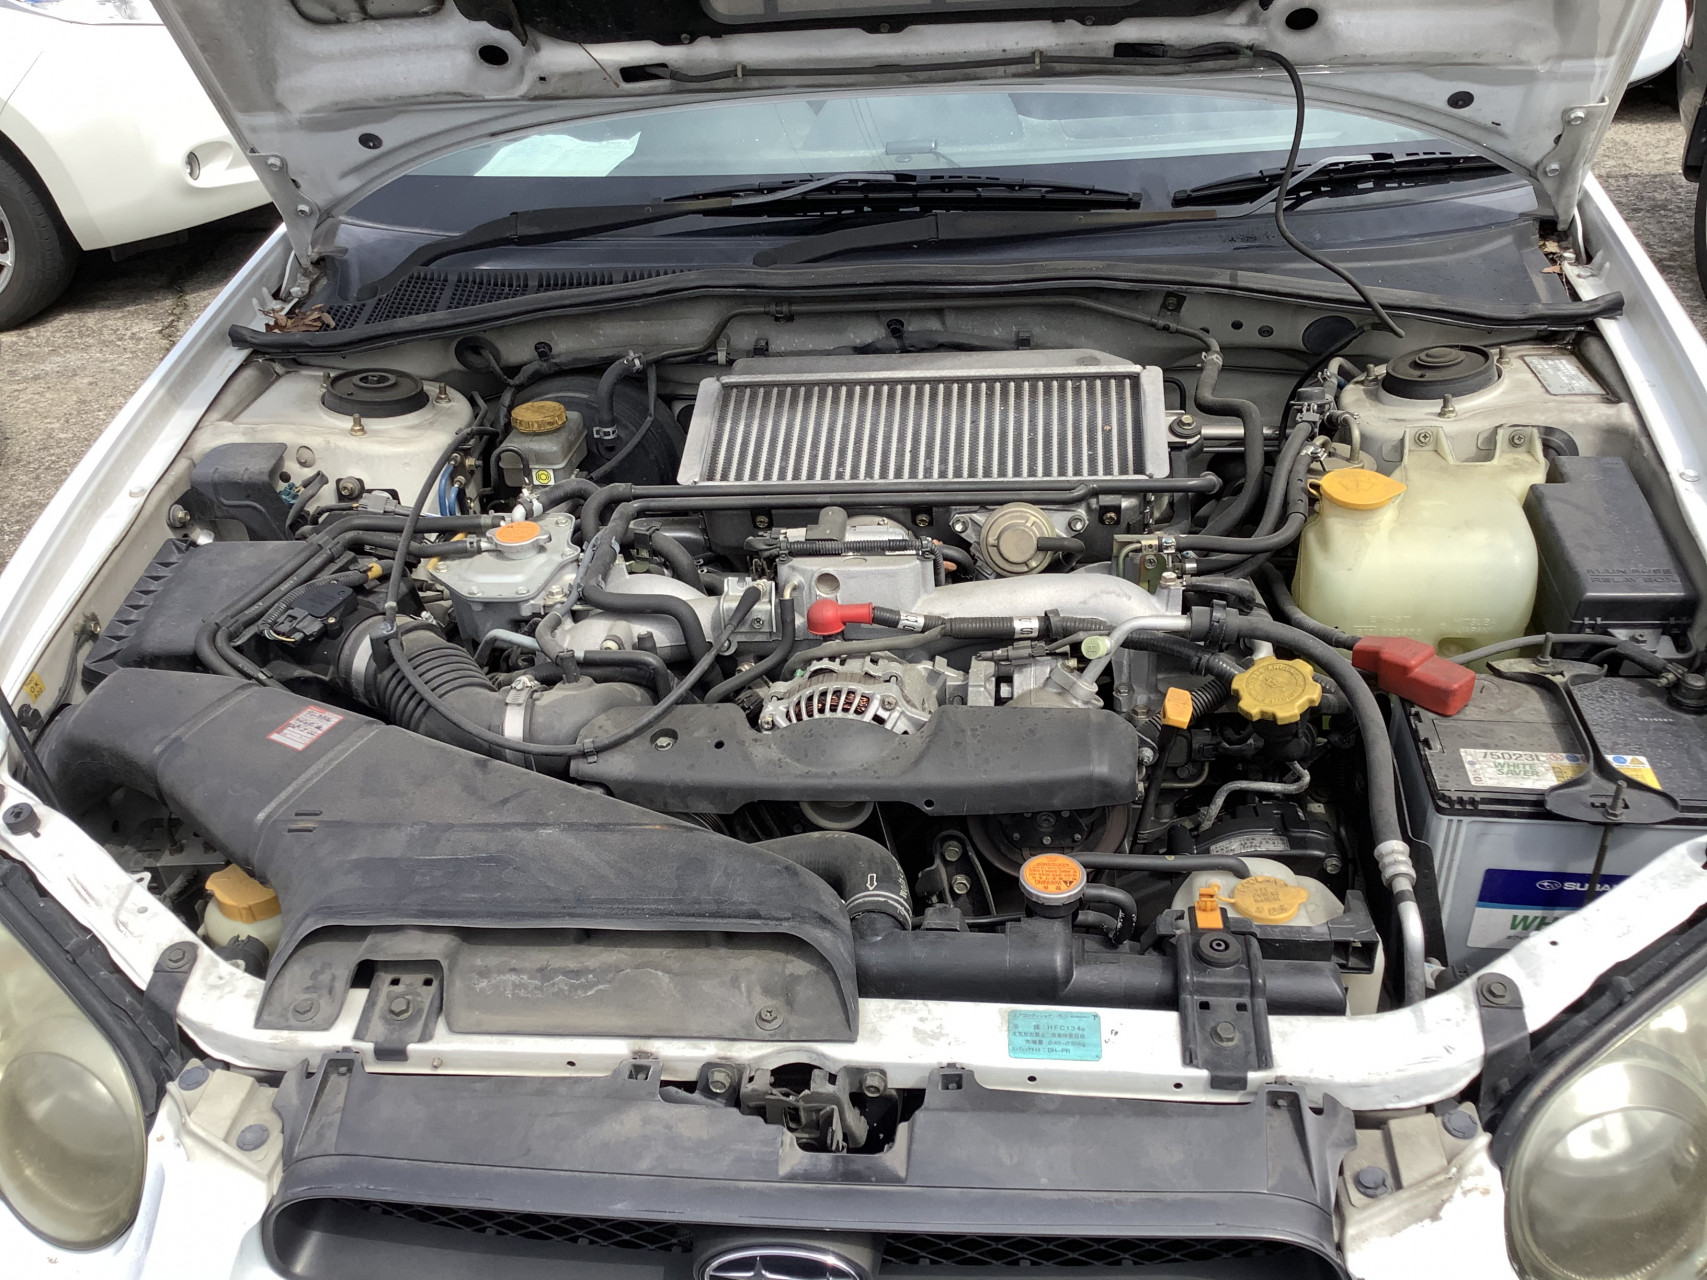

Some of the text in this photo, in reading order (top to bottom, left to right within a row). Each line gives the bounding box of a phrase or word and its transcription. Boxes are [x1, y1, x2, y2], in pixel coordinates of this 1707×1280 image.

[1493, 762, 1537, 770] WHITE
[1497, 769, 1540, 777] SAVER
[1562, 881, 1616, 891] SUBA
